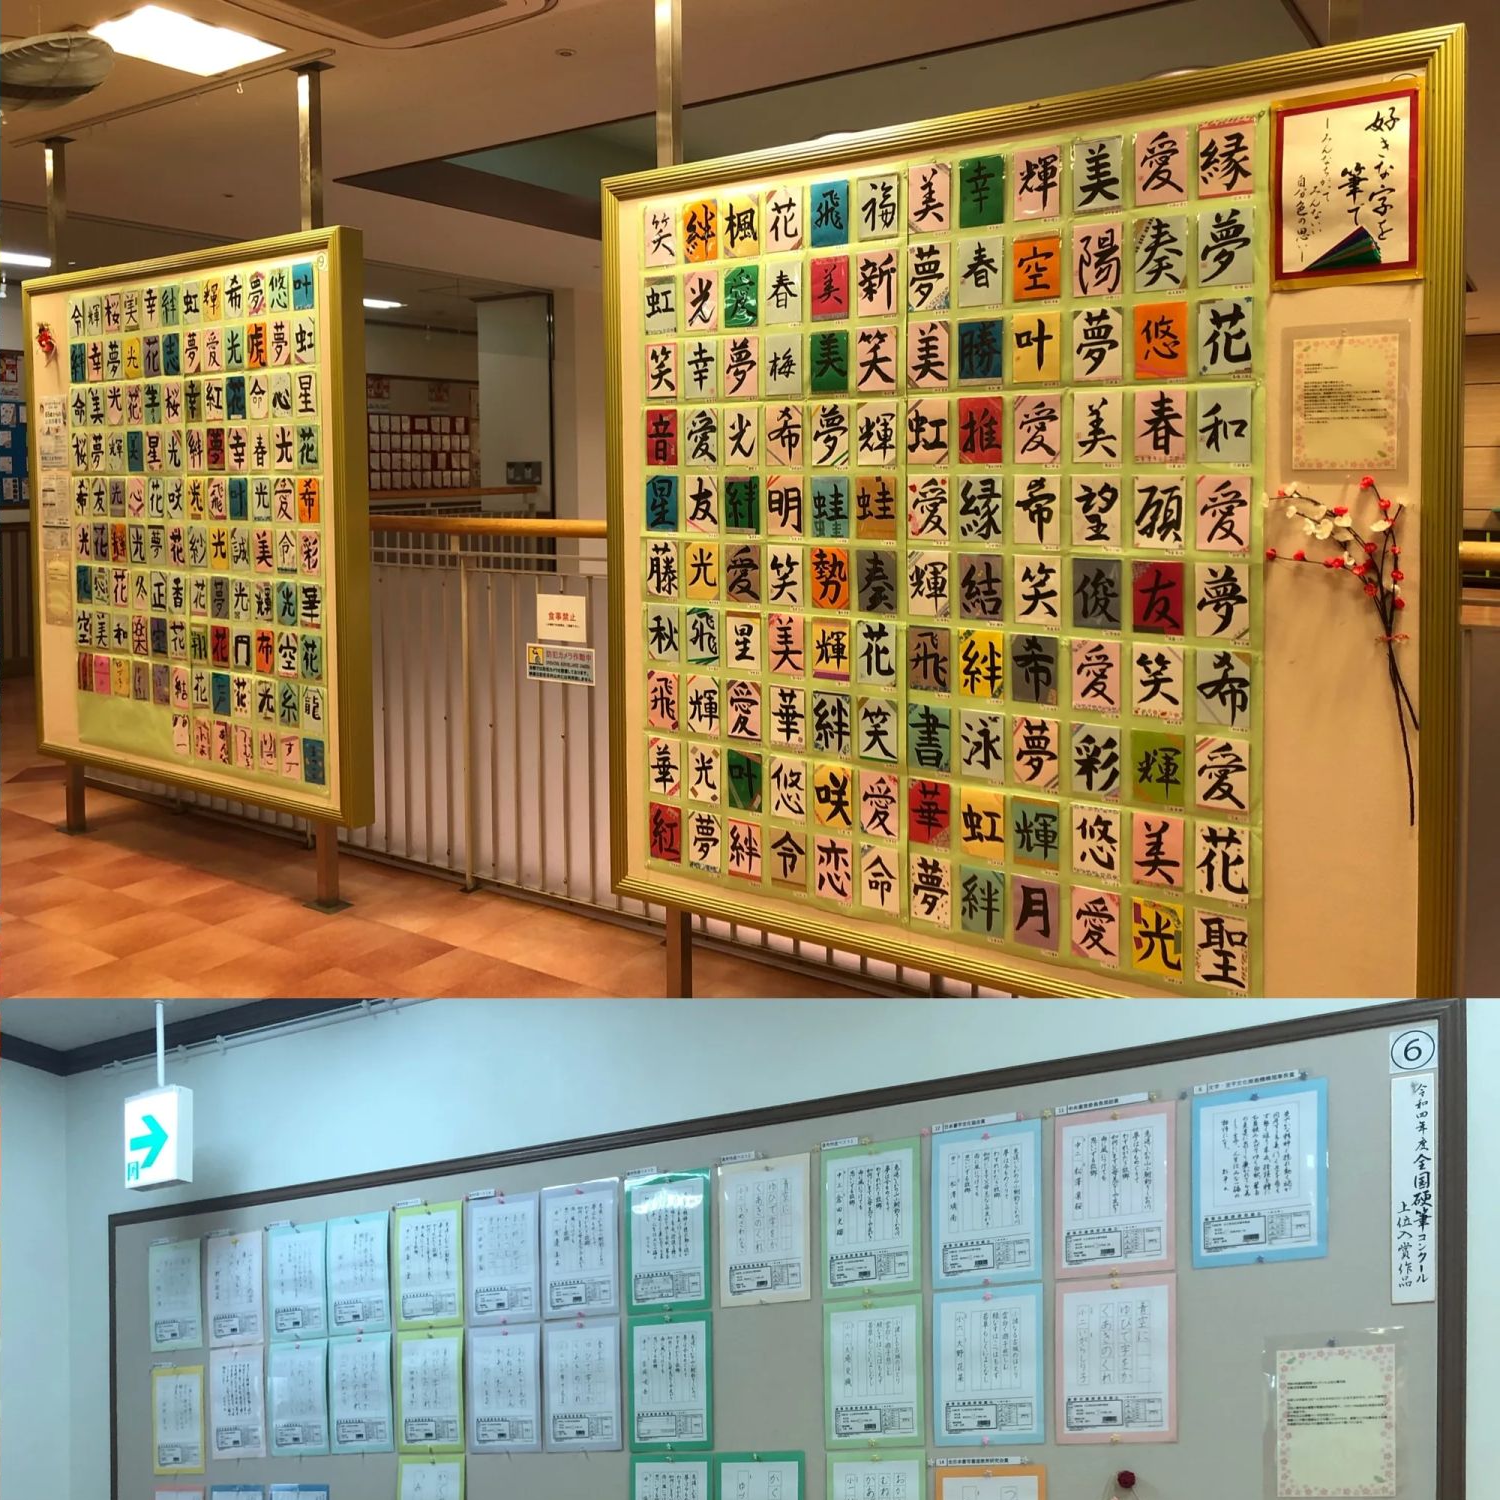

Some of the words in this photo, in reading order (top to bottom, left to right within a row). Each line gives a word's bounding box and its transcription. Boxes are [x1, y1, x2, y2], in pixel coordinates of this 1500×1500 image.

[1019, 153, 1058, 211] 輝
[1078, 143, 1120, 208] 美
[1141, 131, 1184, 193] 愛
[1200, 132, 1251, 191] 縁
[771, 198, 798, 241] 花
[914, 168, 944, 223] 美
[651, 214, 675, 256] 笑
[686, 206, 716, 255] 絆
[725, 203, 757, 248] 楓
[1201, 209, 1250, 283] 夢
[910, 245, 944, 308] 夢
[962, 242, 998, 289] 春
[1018, 247, 1053, 292] 空
[1137, 219, 1183, 288] 奏
[183, 293, 199, 315] 虹
[225, 275, 242, 310] 希
[269, 273, 288, 308] 悠
[646, 288, 674, 319] 虹
[689, 278, 712, 326] 光
[767, 270, 797, 309] 春
[818, 265, 842, 305] 美
[858, 253, 896, 310] 新
[272, 322, 288, 362] 夢
[295, 324, 313, 353] 虹
[858, 330, 894, 387] 笑
[912, 323, 947, 382] 美
[1015, 319, 1053, 371] 叶
[1076, 308, 1119, 375] 夢
[1141, 315, 1180, 360] 悠
[1204, 303, 1251, 366] 花
[650, 346, 675, 391] 笑
[688, 342, 715, 391] 幸
[726, 337, 756, 394] 夢
[769, 348, 796, 380] 梅
[299, 375, 314, 414] 星
[275, 427, 292, 463] 光
[648, 416, 674, 462] 音
[768, 405, 801, 462] 希
[858, 413, 896, 460] 輝
[908, 410, 947, 452] 虹
[1019, 402, 1059, 456] 愛
[1078, 397, 1117, 459] 美
[1139, 391, 1184, 454] 春
[1199, 403, 1248, 452] 和
[690, 477, 717, 525] 友
[768, 486, 802, 533] 明
[960, 478, 1002, 539] 縁
[1075, 483, 1119, 541] 望
[1135, 485, 1182, 544] 願
[1200, 480, 1247, 546] 愛
[650, 542, 678, 596] 藤
[689, 548, 716, 587] 光
[813, 550, 846, 604] 勢
[1020, 562, 1058, 617] 笑
[548, 611, 576, 622] 食事禁止
[1197, 565, 1247, 635] 夢
[649, 615, 678, 654] 秋
[734, 624, 755, 662] 星
[859, 623, 894, 676] 花
[772, 689, 804, 742] 華
[909, 704, 949, 769] 書
[962, 719, 1002, 770] 泳
[1075, 735, 1120, 791] 彩
[815, 772, 852, 826] 咲
[863, 777, 896, 837] 愛
[962, 804, 1004, 843] 虹
[693, 814, 719, 860] 夢
[1135, 821, 1179, 884] 美
[1196, 827, 1248, 894] 花
[817, 839, 850, 898] 恋
[864, 855, 896, 907] 命
[1016, 886, 1050, 937] 月
[1076, 897, 1115, 956] 愛
[1200, 917, 1247, 987] 聖
[1397, 1201, 1413, 1288] 上位入賞作品
